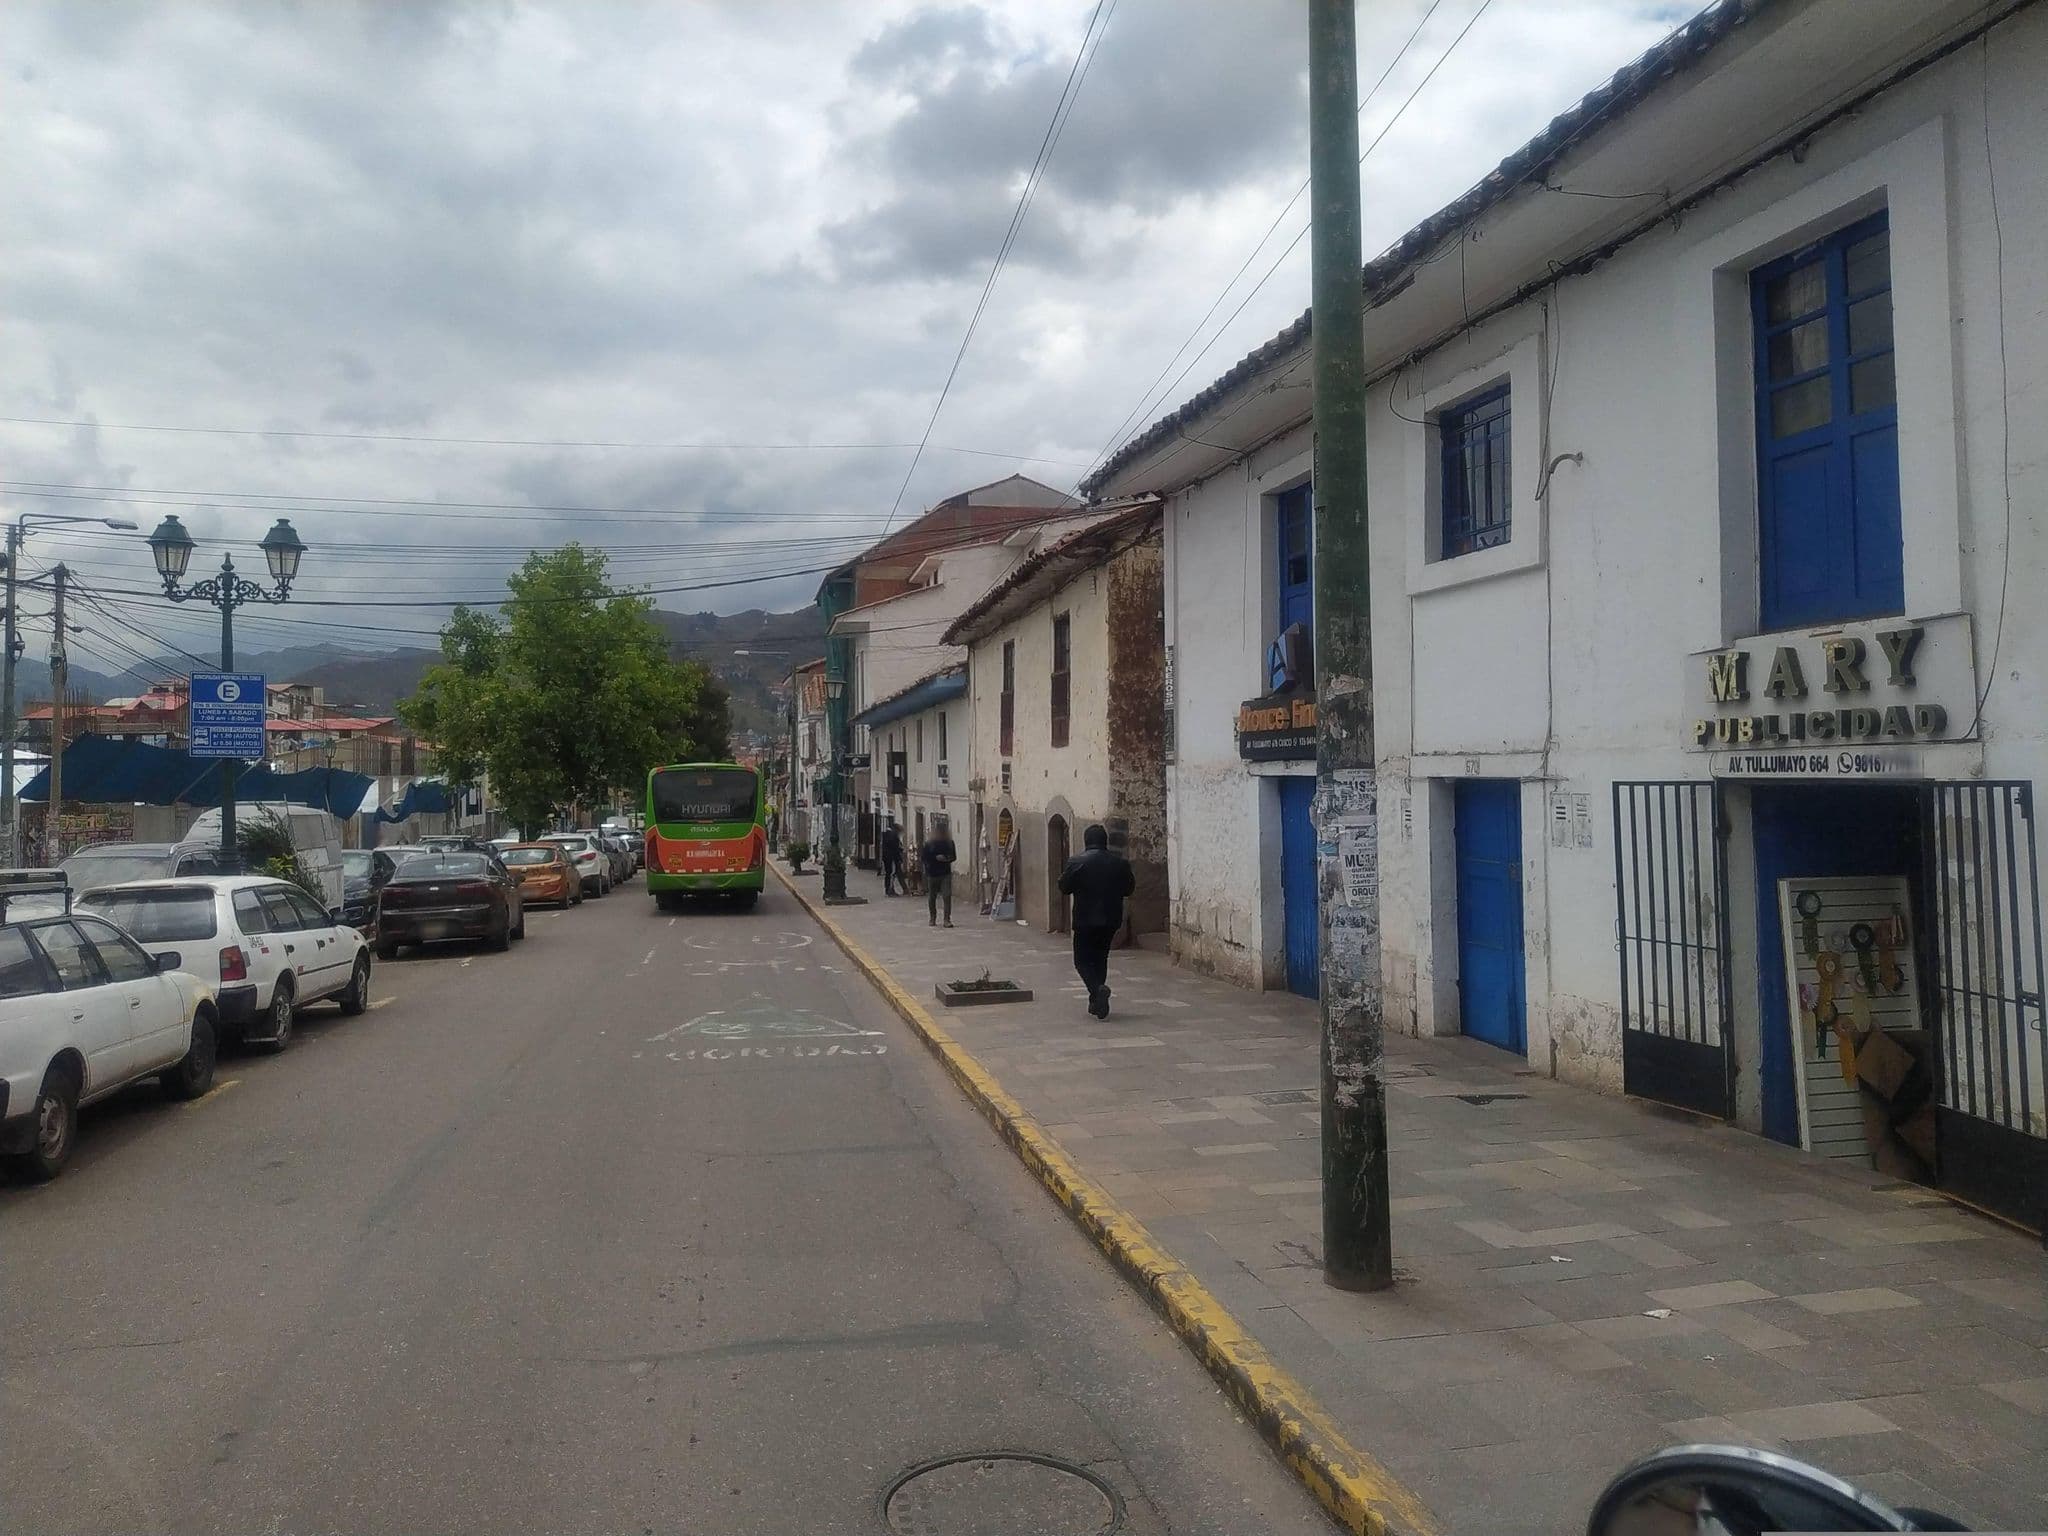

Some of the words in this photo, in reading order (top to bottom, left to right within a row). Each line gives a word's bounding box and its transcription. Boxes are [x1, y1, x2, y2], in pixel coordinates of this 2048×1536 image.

[1705, 627, 1924, 702] MARY
[223, 684, 235, 698] E
[1694, 704, 1947, 745] PUBLICIDAD
[1729, 756, 1743, 773] AV.
[1745, 755, 1807, 773] TULLUMAYO
[1809, 755, 1829, 772] 664
[681, 804, 731, 814] HYUNDAI
